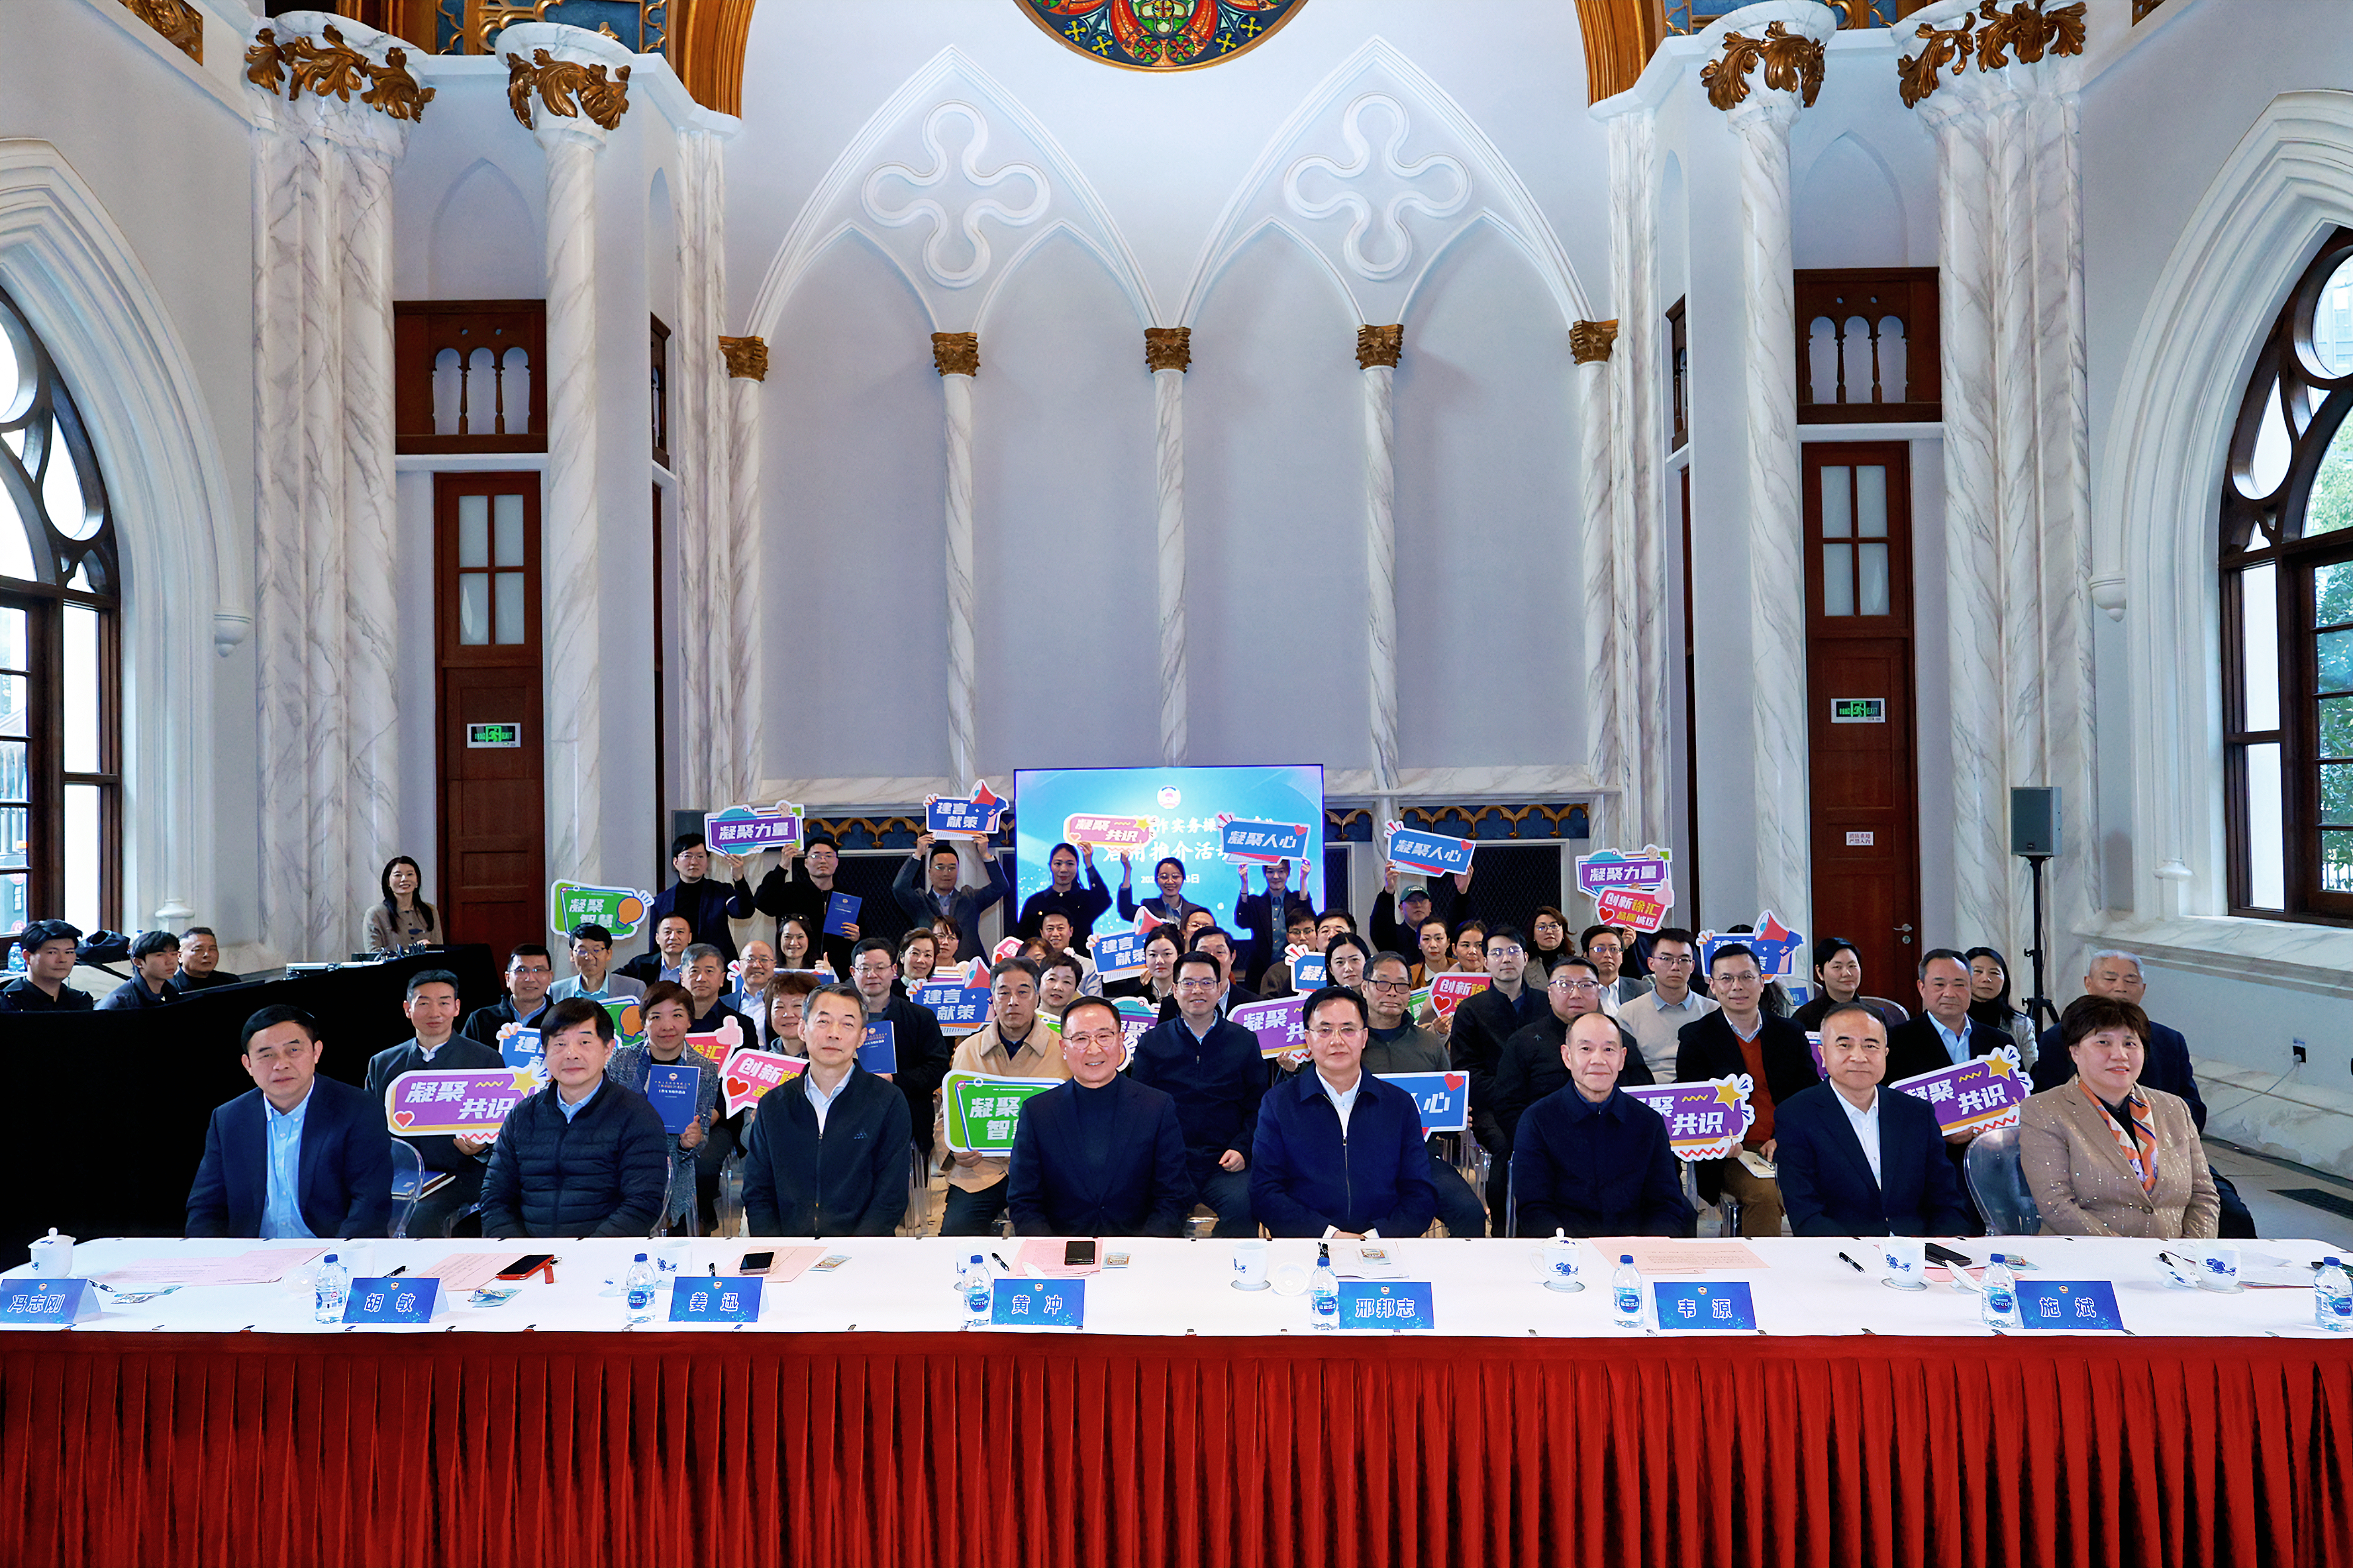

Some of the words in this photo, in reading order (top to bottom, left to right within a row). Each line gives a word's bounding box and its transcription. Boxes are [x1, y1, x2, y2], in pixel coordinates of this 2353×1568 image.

[936, 802, 968, 815] 建言
[719, 822, 789, 840] 凝聚力量
[946, 816, 979, 828] 献策
[1075, 819, 1111, 831] 凝聚
[1105, 829, 1138, 842] 共识
[1227, 830, 1297, 848] 凝聚人心
[1395, 839, 1462, 862] 凝聚人心
[1589, 865, 1657, 882] 凝聚力量
[568, 899, 605, 913] 凝聚
[1605, 892, 1660, 916] 创新徐汇
[1102, 937, 1134, 954] 建言
[1115, 948, 1146, 966] 献策
[1299, 965, 1327, 982] 凝
[923, 989, 962, 1004] 建言
[937, 1005, 976, 1020] 献策
[1243, 1008, 1288, 1032] 凝聚
[405, 1081, 469, 1103] 凝聚
[1958, 1083, 2008, 1115] 共识
[457, 1098, 516, 1119] 共识
[969, 1097, 1021, 1117] 凝聚
[1672, 1112, 1724, 1136] 共识
[7, 1294, 65, 1313] 冯志刚
[364, 1293, 416, 1312] 胡敏
[689, 1292, 739, 1312] 姜迅
[1011, 1295, 1062, 1315] 黄冲
[1355, 1298, 1415, 1318] 邢邦志
[1678, 1299, 1733, 1319] 韦源
[2039, 1297, 2097, 1318] 施斌
